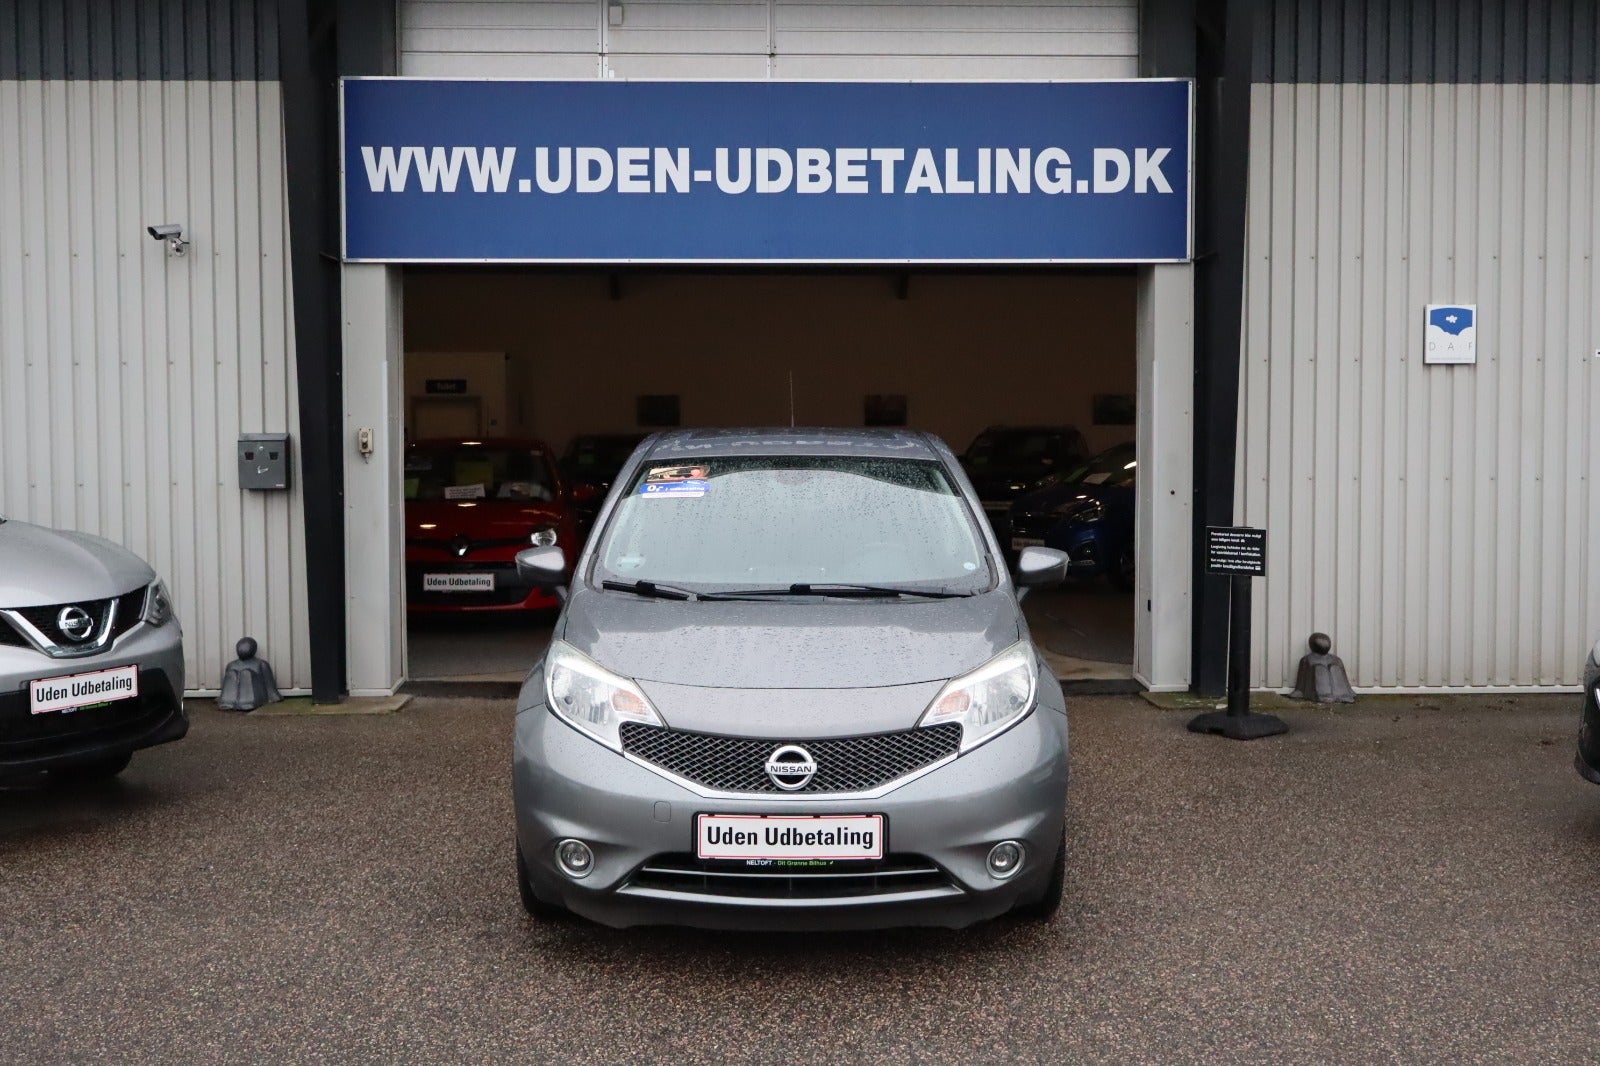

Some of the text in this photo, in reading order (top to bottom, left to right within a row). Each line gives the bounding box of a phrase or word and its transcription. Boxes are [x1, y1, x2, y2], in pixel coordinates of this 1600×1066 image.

[361, 146, 1174, 195] WWW.UDEN-UDBETALING.DK
[427, 578, 491, 587] Uden Udbetaling
[36, 676, 132, 703] Uden Udbetaling
[770, 765, 812, 773] NISSAN
[707, 826, 873, 849] Uden Udbetaling
